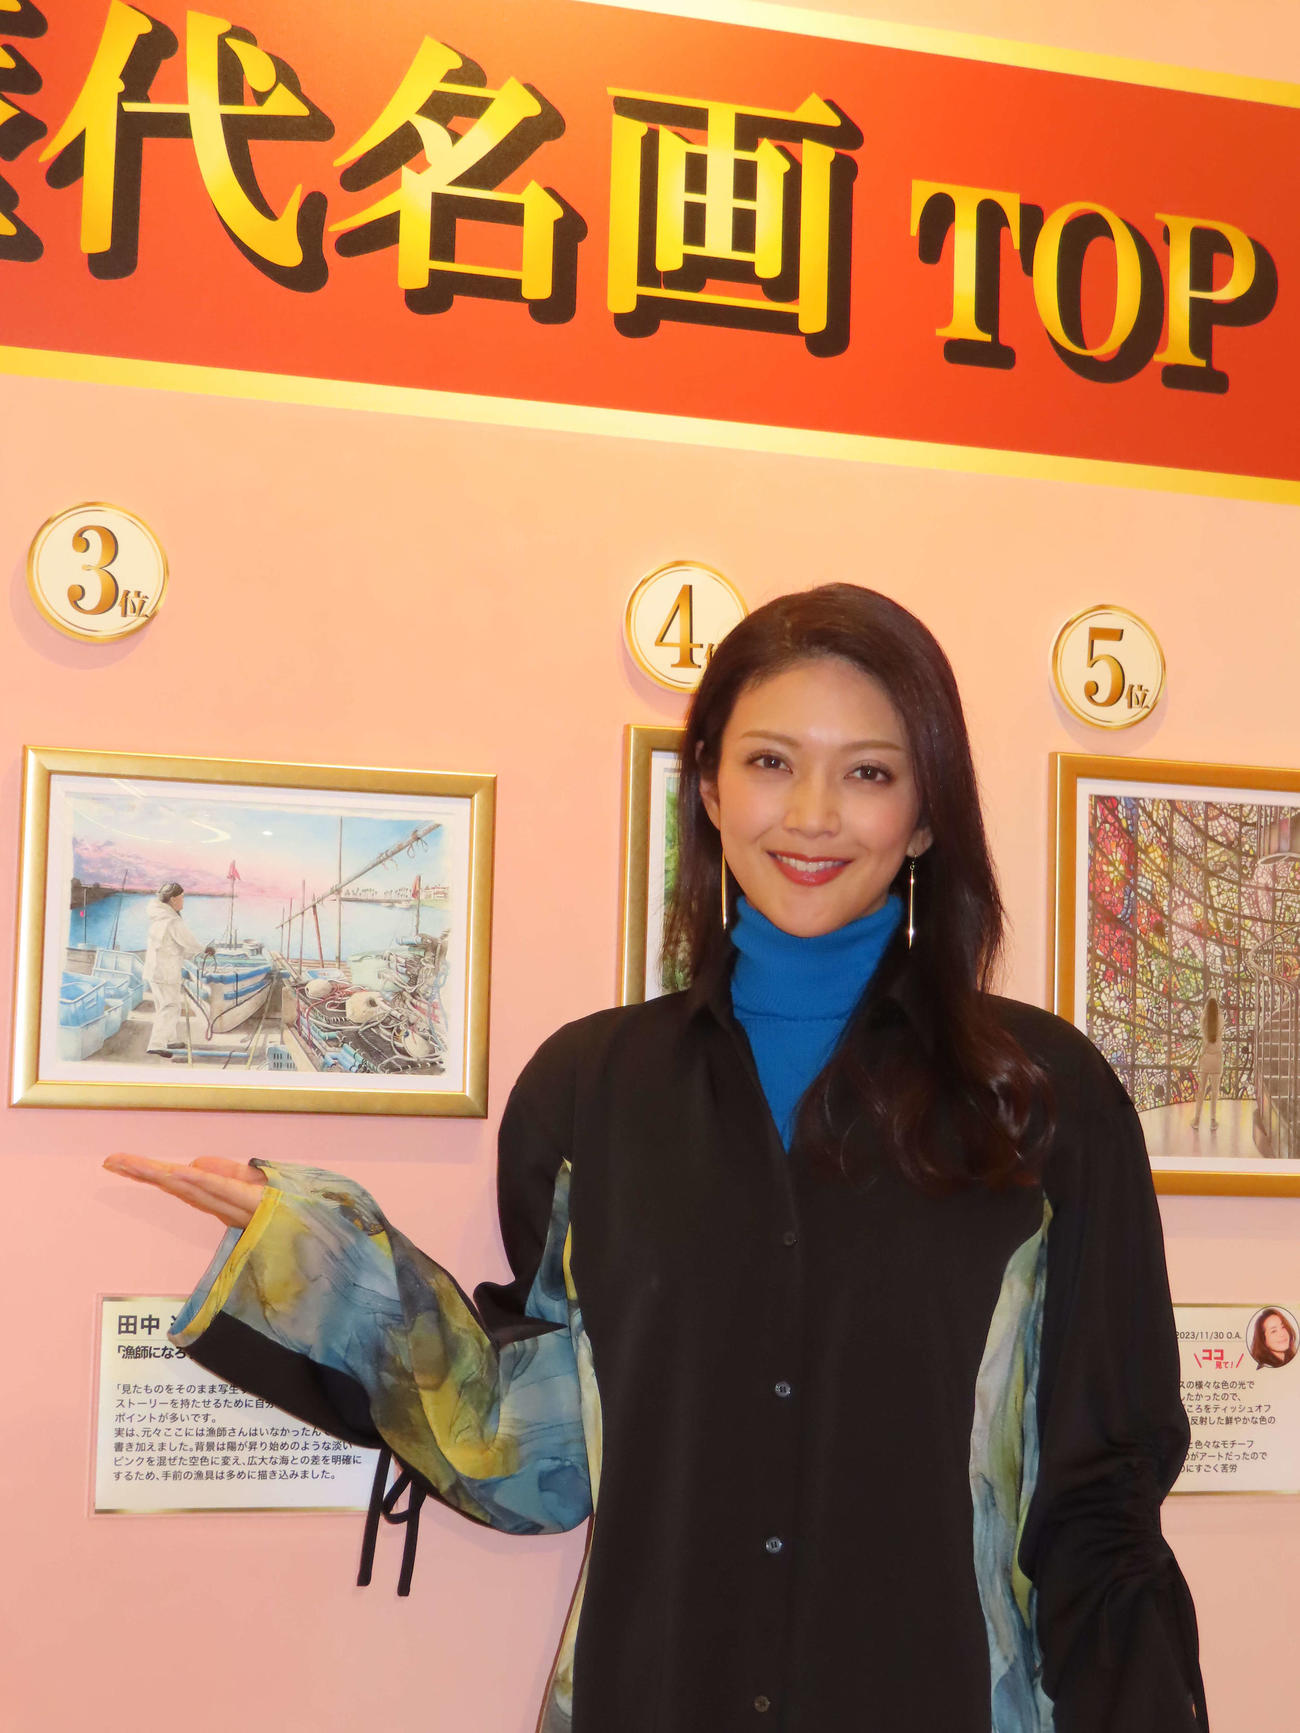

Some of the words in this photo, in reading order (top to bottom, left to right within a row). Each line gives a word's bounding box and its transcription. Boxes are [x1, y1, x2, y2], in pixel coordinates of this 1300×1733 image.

[0, 0, 860, 355] 代名画
[910, 178, 1278, 394] TOP
[67, 525, 150, 618] 3位
[1084, 626, 1150, 709] 5位
[118, 1314, 160, 1336] 田中
[1176, 1331, 1225, 1340] 2023/11/30
[1202, 1349, 1225, 1361] ココ
[1184, 1404, 1271, 1414] ころをティッシュオフ
[115, 1413, 217, 1424] ポイントが多いです。
